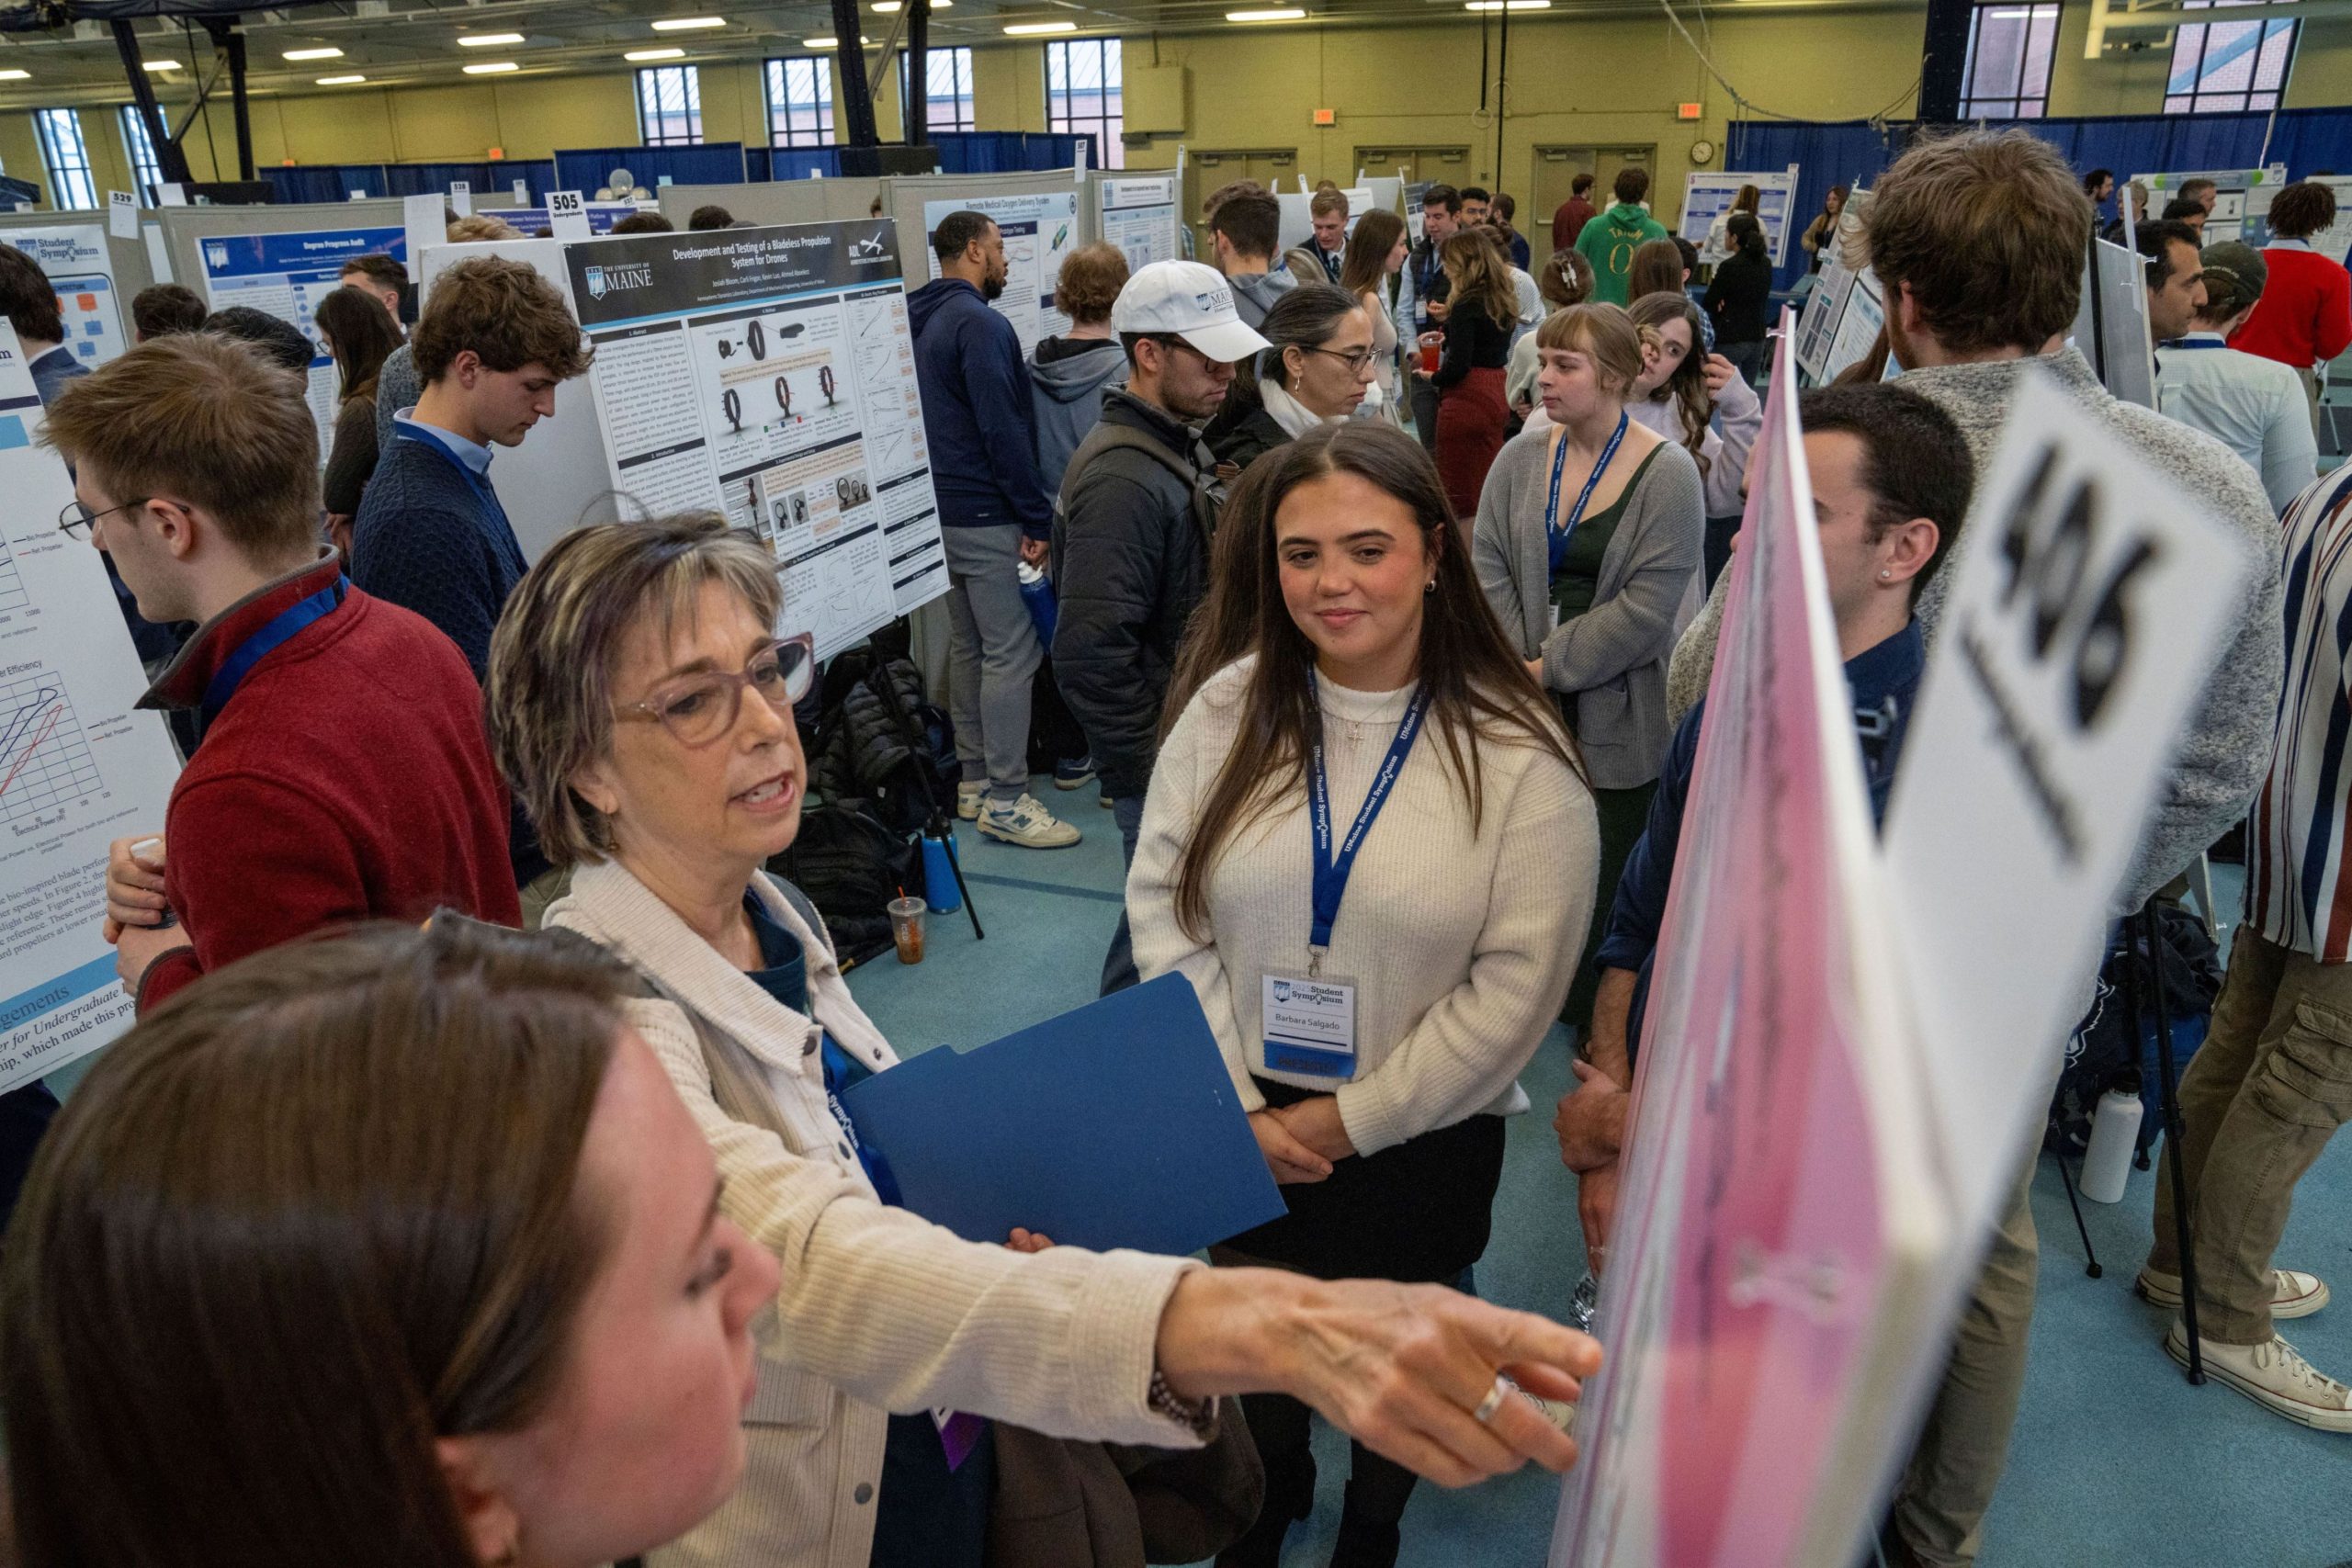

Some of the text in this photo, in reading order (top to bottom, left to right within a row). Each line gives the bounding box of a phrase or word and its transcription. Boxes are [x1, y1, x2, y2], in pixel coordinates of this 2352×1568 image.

[114, 193, 132, 203] 529
[553, 194, 579, 210] 505
[553, 211, 583, 220] Undergraduate
[38, 238, 75, 248] Student
[673, 245, 722, 261] Development
[722, 243, 735, 255] and
[735, 241, 759, 254] Testing
[759, 240, 766, 253] of
[772, 238, 801, 251] Bladeless
[801, 235, 831, 248] Propulsion
[848, 244, 860, 257] ADL
[40, 246, 98, 263] Symposium
[731, 254, 788, 269] System for Drones
[615, 263, 642, 272] UNIVERSITY
[605, 268, 653, 291] MAINE
[6, 660, 42, 676] Efficiency
[1400, 712, 1418, 740] UMaine
[101, 791, 111, 799] 120
[1344, 755, 1399, 853] UMaine Student Symposium
[15, 822, 40, 837] Electrical
[40, 817, 57, 829] Power
[1317, 804, 1329, 851] Symposium
[8, 848, 26, 859] Power
[35, 835, 60, 849] Electrical
[60, 829, 76, 840] Power
[40, 841, 63, 855] propeller
[6, 874, 58, 902] bio-inspired
[58, 865, 81, 883] blade
[13, 897, 43, 914] speeds.
[44, 891, 54, 901] In
[55, 880, 82, 897] Figure
[23, 908, 47, 922] edge.
[47, 896, 74, 912] Figure
[75, 891, 82, 900] 4
[6, 898, 101, 943] reference. These results
[13, 931, 55, 956] propellers
[56, 927, 65, 936] at
[65, 916, 88, 932] lower
[1292, 983, 1344, 998] 2025 Student
[1292, 990, 1343, 1006] Symposium
[12, 1030, 31, 1051] for
[33, 988, 119, 1036] Undergraduate
[1275, 1013, 1340, 1031] Barbara Salgado
[22, 1035, 61, 1060] which
[62, 1019, 94, 1043] made
[95, 1009, 116, 1026] this
